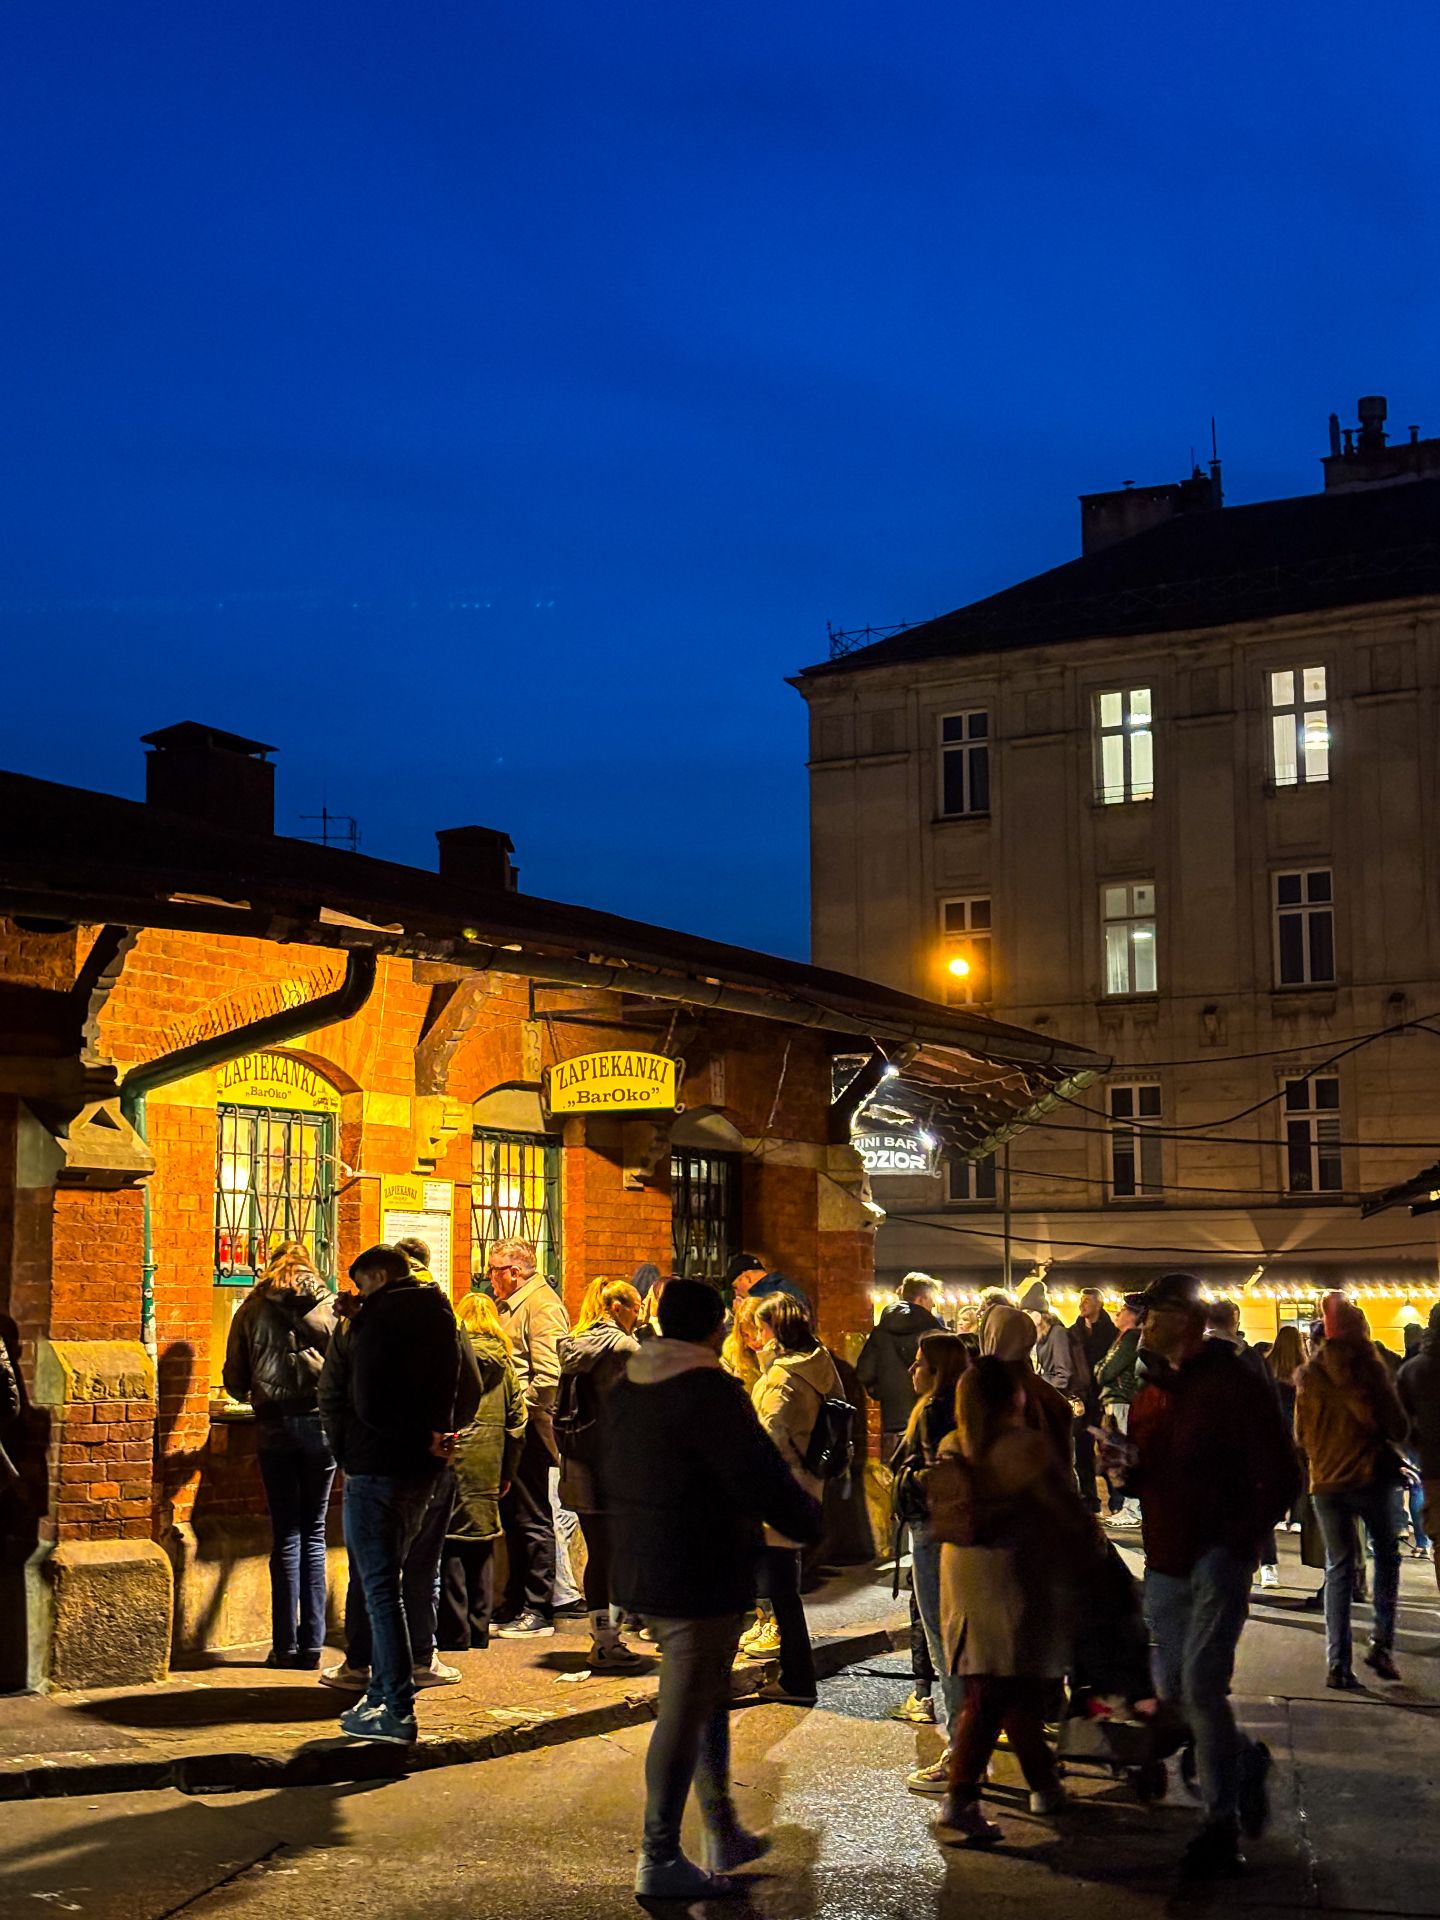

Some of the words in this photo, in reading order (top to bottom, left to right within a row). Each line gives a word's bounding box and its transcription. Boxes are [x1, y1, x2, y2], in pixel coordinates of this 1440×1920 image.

[221, 1054, 317, 1098] ZAPIEKANKI
[555, 1055, 670, 1090] ZAPIEKANKI
[884, 1136, 919, 1152] BAR
[384, 1185, 418, 1200] ZAPIEKANKI
